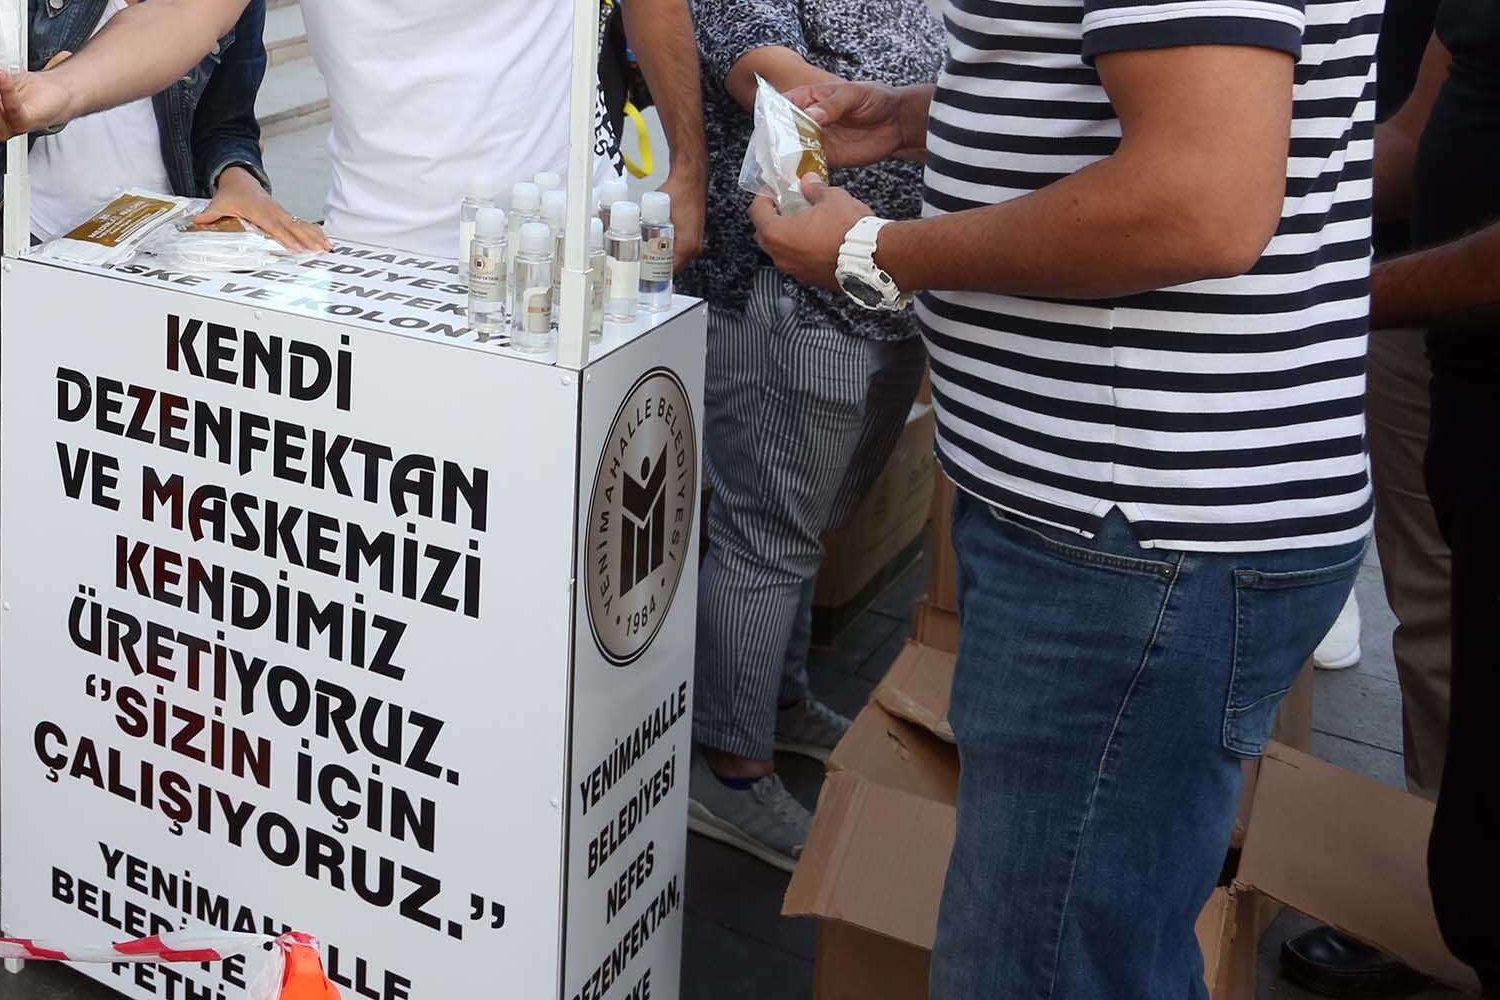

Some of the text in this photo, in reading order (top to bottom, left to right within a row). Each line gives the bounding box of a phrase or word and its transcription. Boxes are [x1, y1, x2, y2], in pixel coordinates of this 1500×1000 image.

[102, 262, 211, 287] SKE
[219, 282, 282, 300] VE
[231, 268, 470, 317] EZENFEK
[300, 258, 469, 295] EDİYES
[332, 245, 461, 276] MAHA
[167, 314, 351, 411] KENDİ
[56, 367, 488, 532] DEZENFEKTAN
[596, 397, 686, 615] YENİMAHALLE BELEDİYESİ
[56, 442, 480, 618] VE MASKEMİZİ
[116, 535, 407, 681] KENDİMİZ
[626, 595, 656, 637] 1984
[69, 584, 459, 785] ÜRETİYORUZ.
[297, 738, 436, 852] İÇİN
[580, 681, 687, 815] YENİMAHALLE
[588, 745, 676, 879] BELEDİYESİ
[99, 842, 411, 1000] YENİMAHLLE
[572, 875, 680, 1000] EZENFEKTAN,
[606, 840, 654, 925] NEFES
